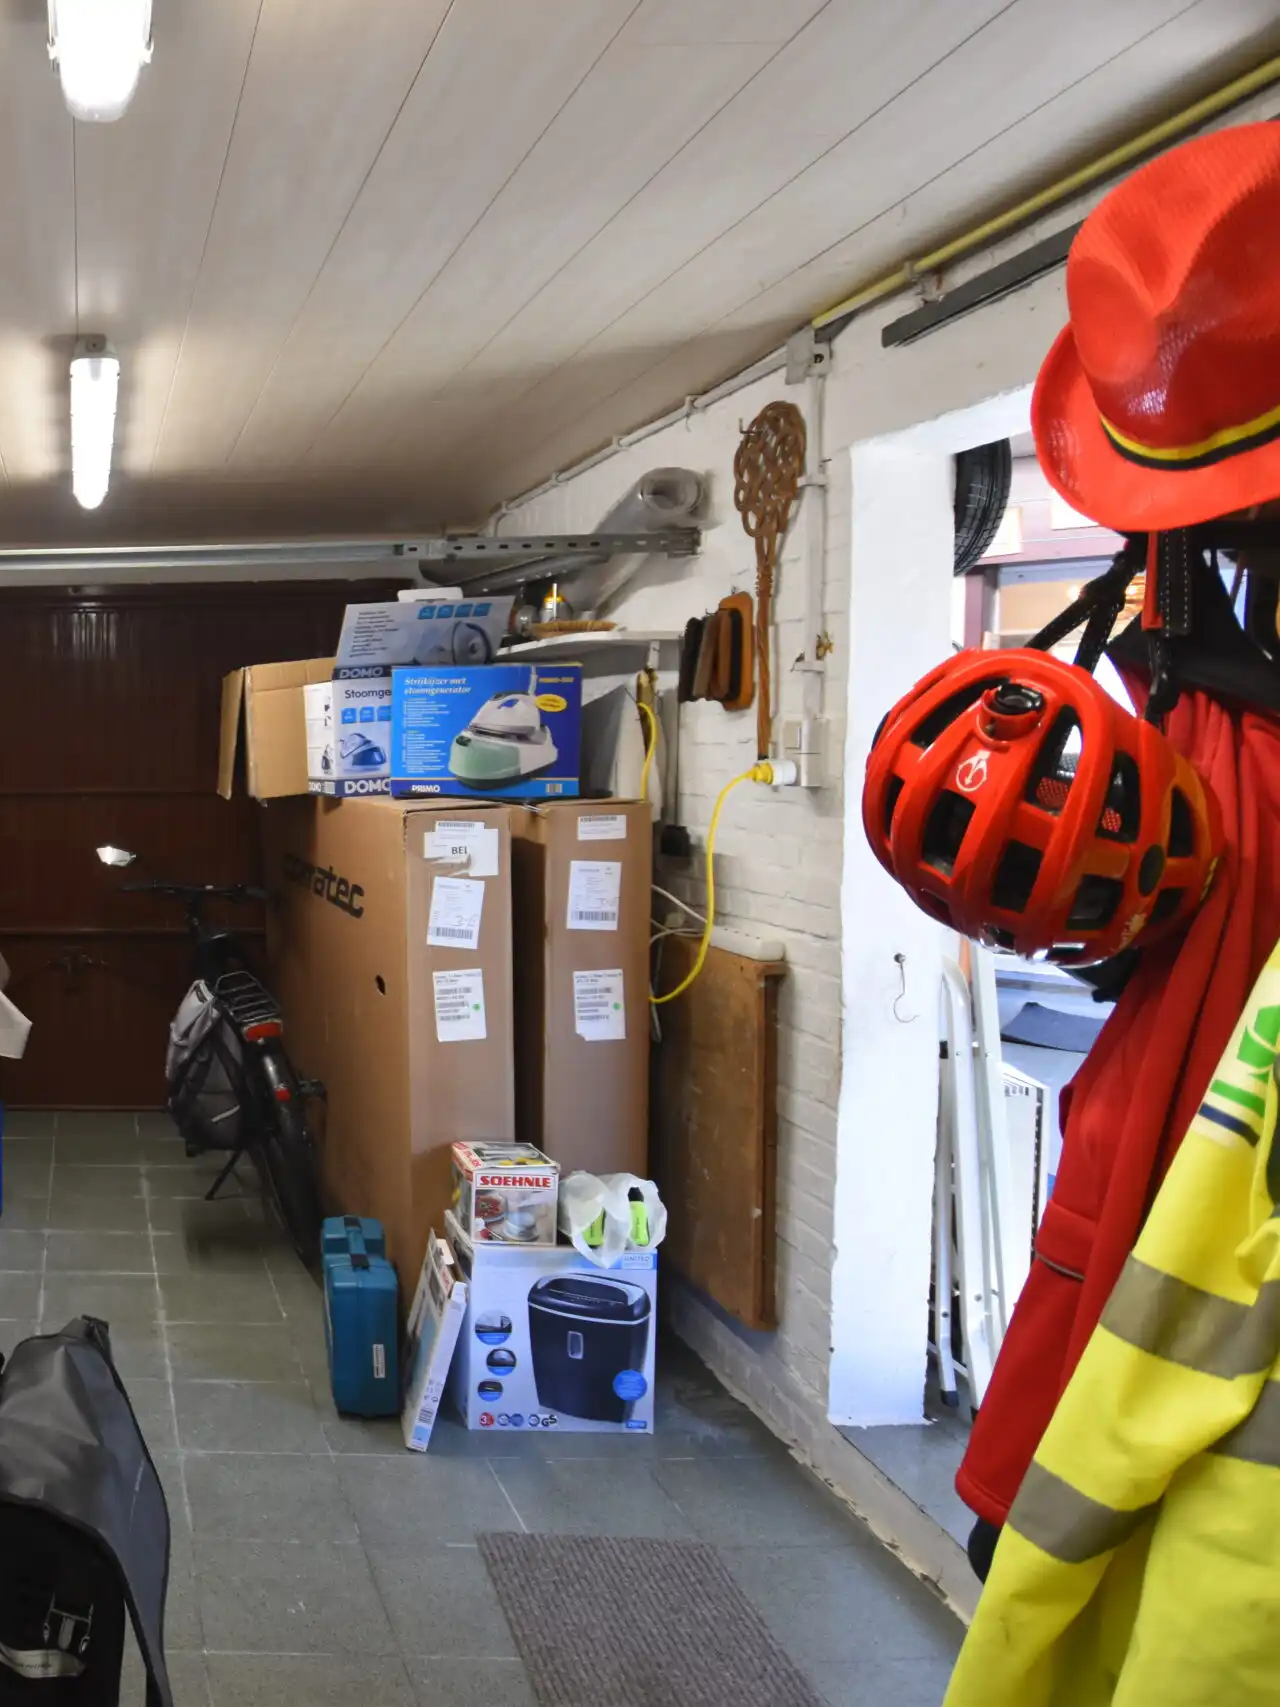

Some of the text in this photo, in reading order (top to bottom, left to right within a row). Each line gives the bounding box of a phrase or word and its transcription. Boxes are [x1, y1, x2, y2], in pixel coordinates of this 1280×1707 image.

[339, 667, 384, 679] DOMO
[411, 783, 441, 793] PRIMO
[479, 1175, 551, 1189] SOEHNLE
